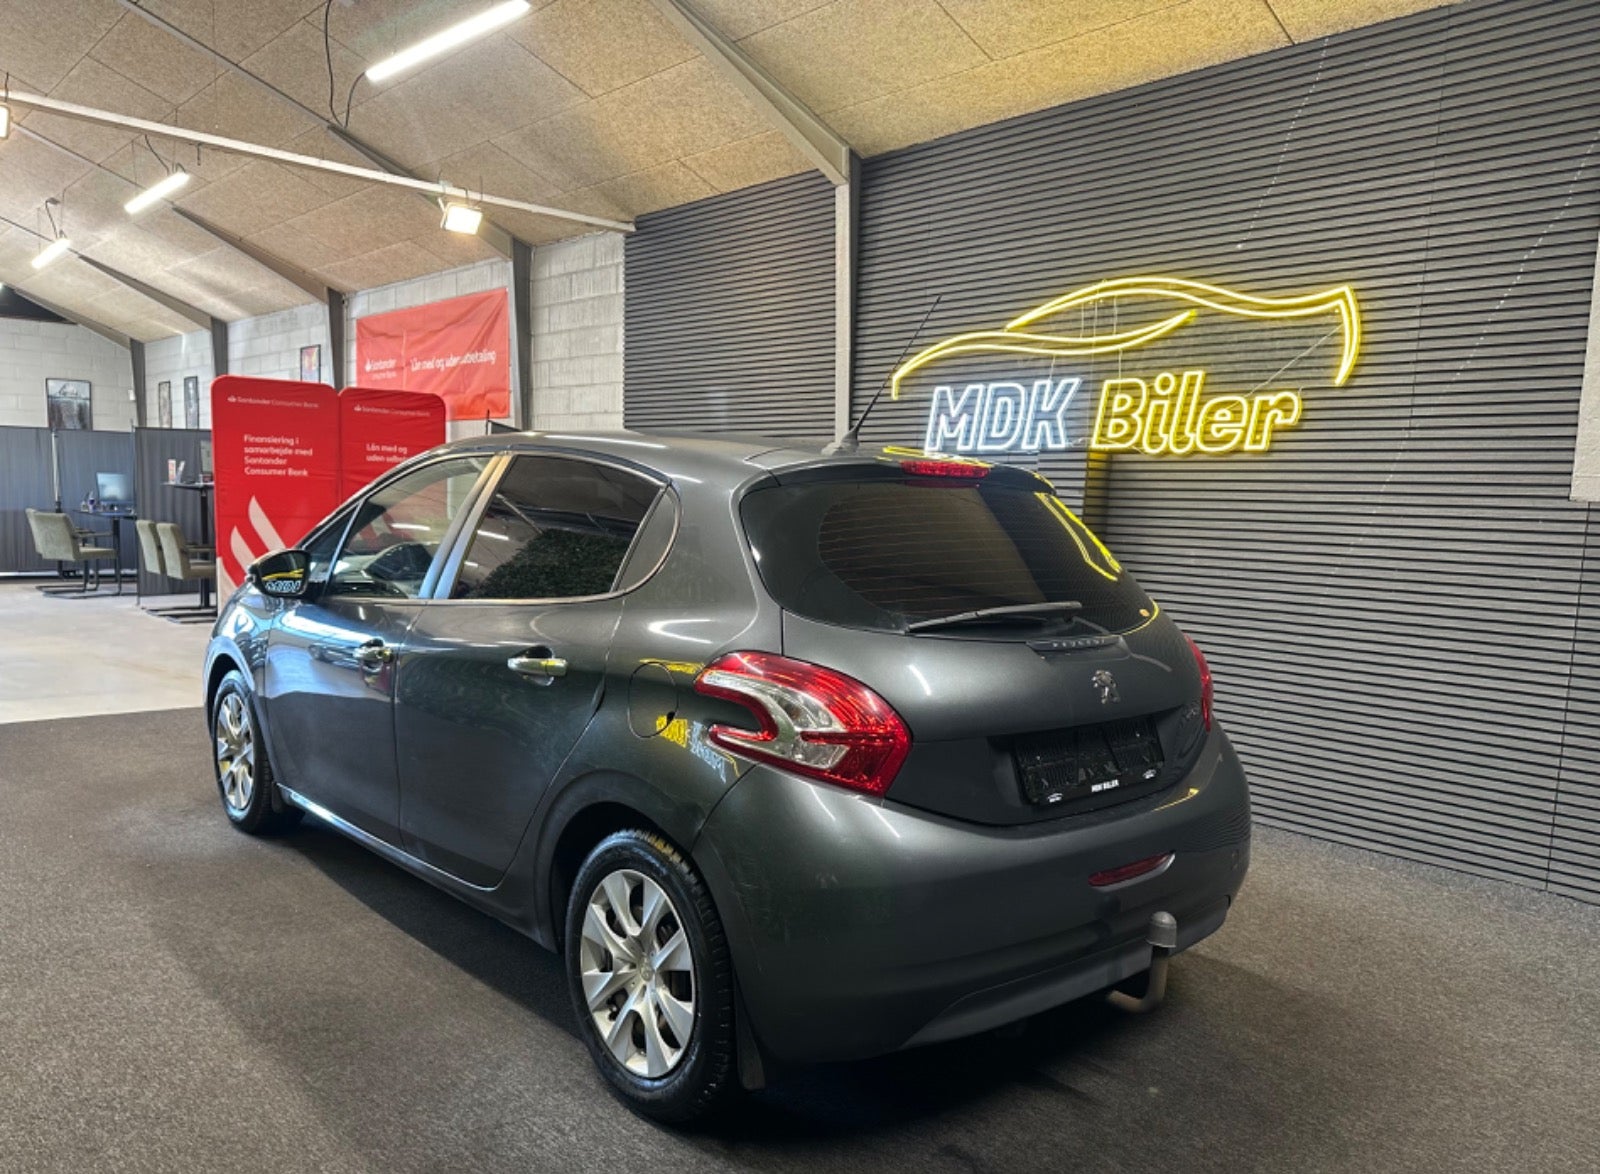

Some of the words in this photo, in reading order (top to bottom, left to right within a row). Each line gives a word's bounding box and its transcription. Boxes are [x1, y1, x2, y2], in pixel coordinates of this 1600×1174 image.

[923, 377, 1081, 453] MDK
[1092, 371, 1302, 455] Biler
[243, 434, 294, 446] Finansiering
[244, 446, 293, 456] samarbejde
[294, 448, 313, 456] med
[381, 445, 397, 453] med
[398, 446, 408, 454] og
[244, 455, 288, 465] Santander
[244, 466, 286, 476] Consumer
[287, 467, 309, 477] Bank
